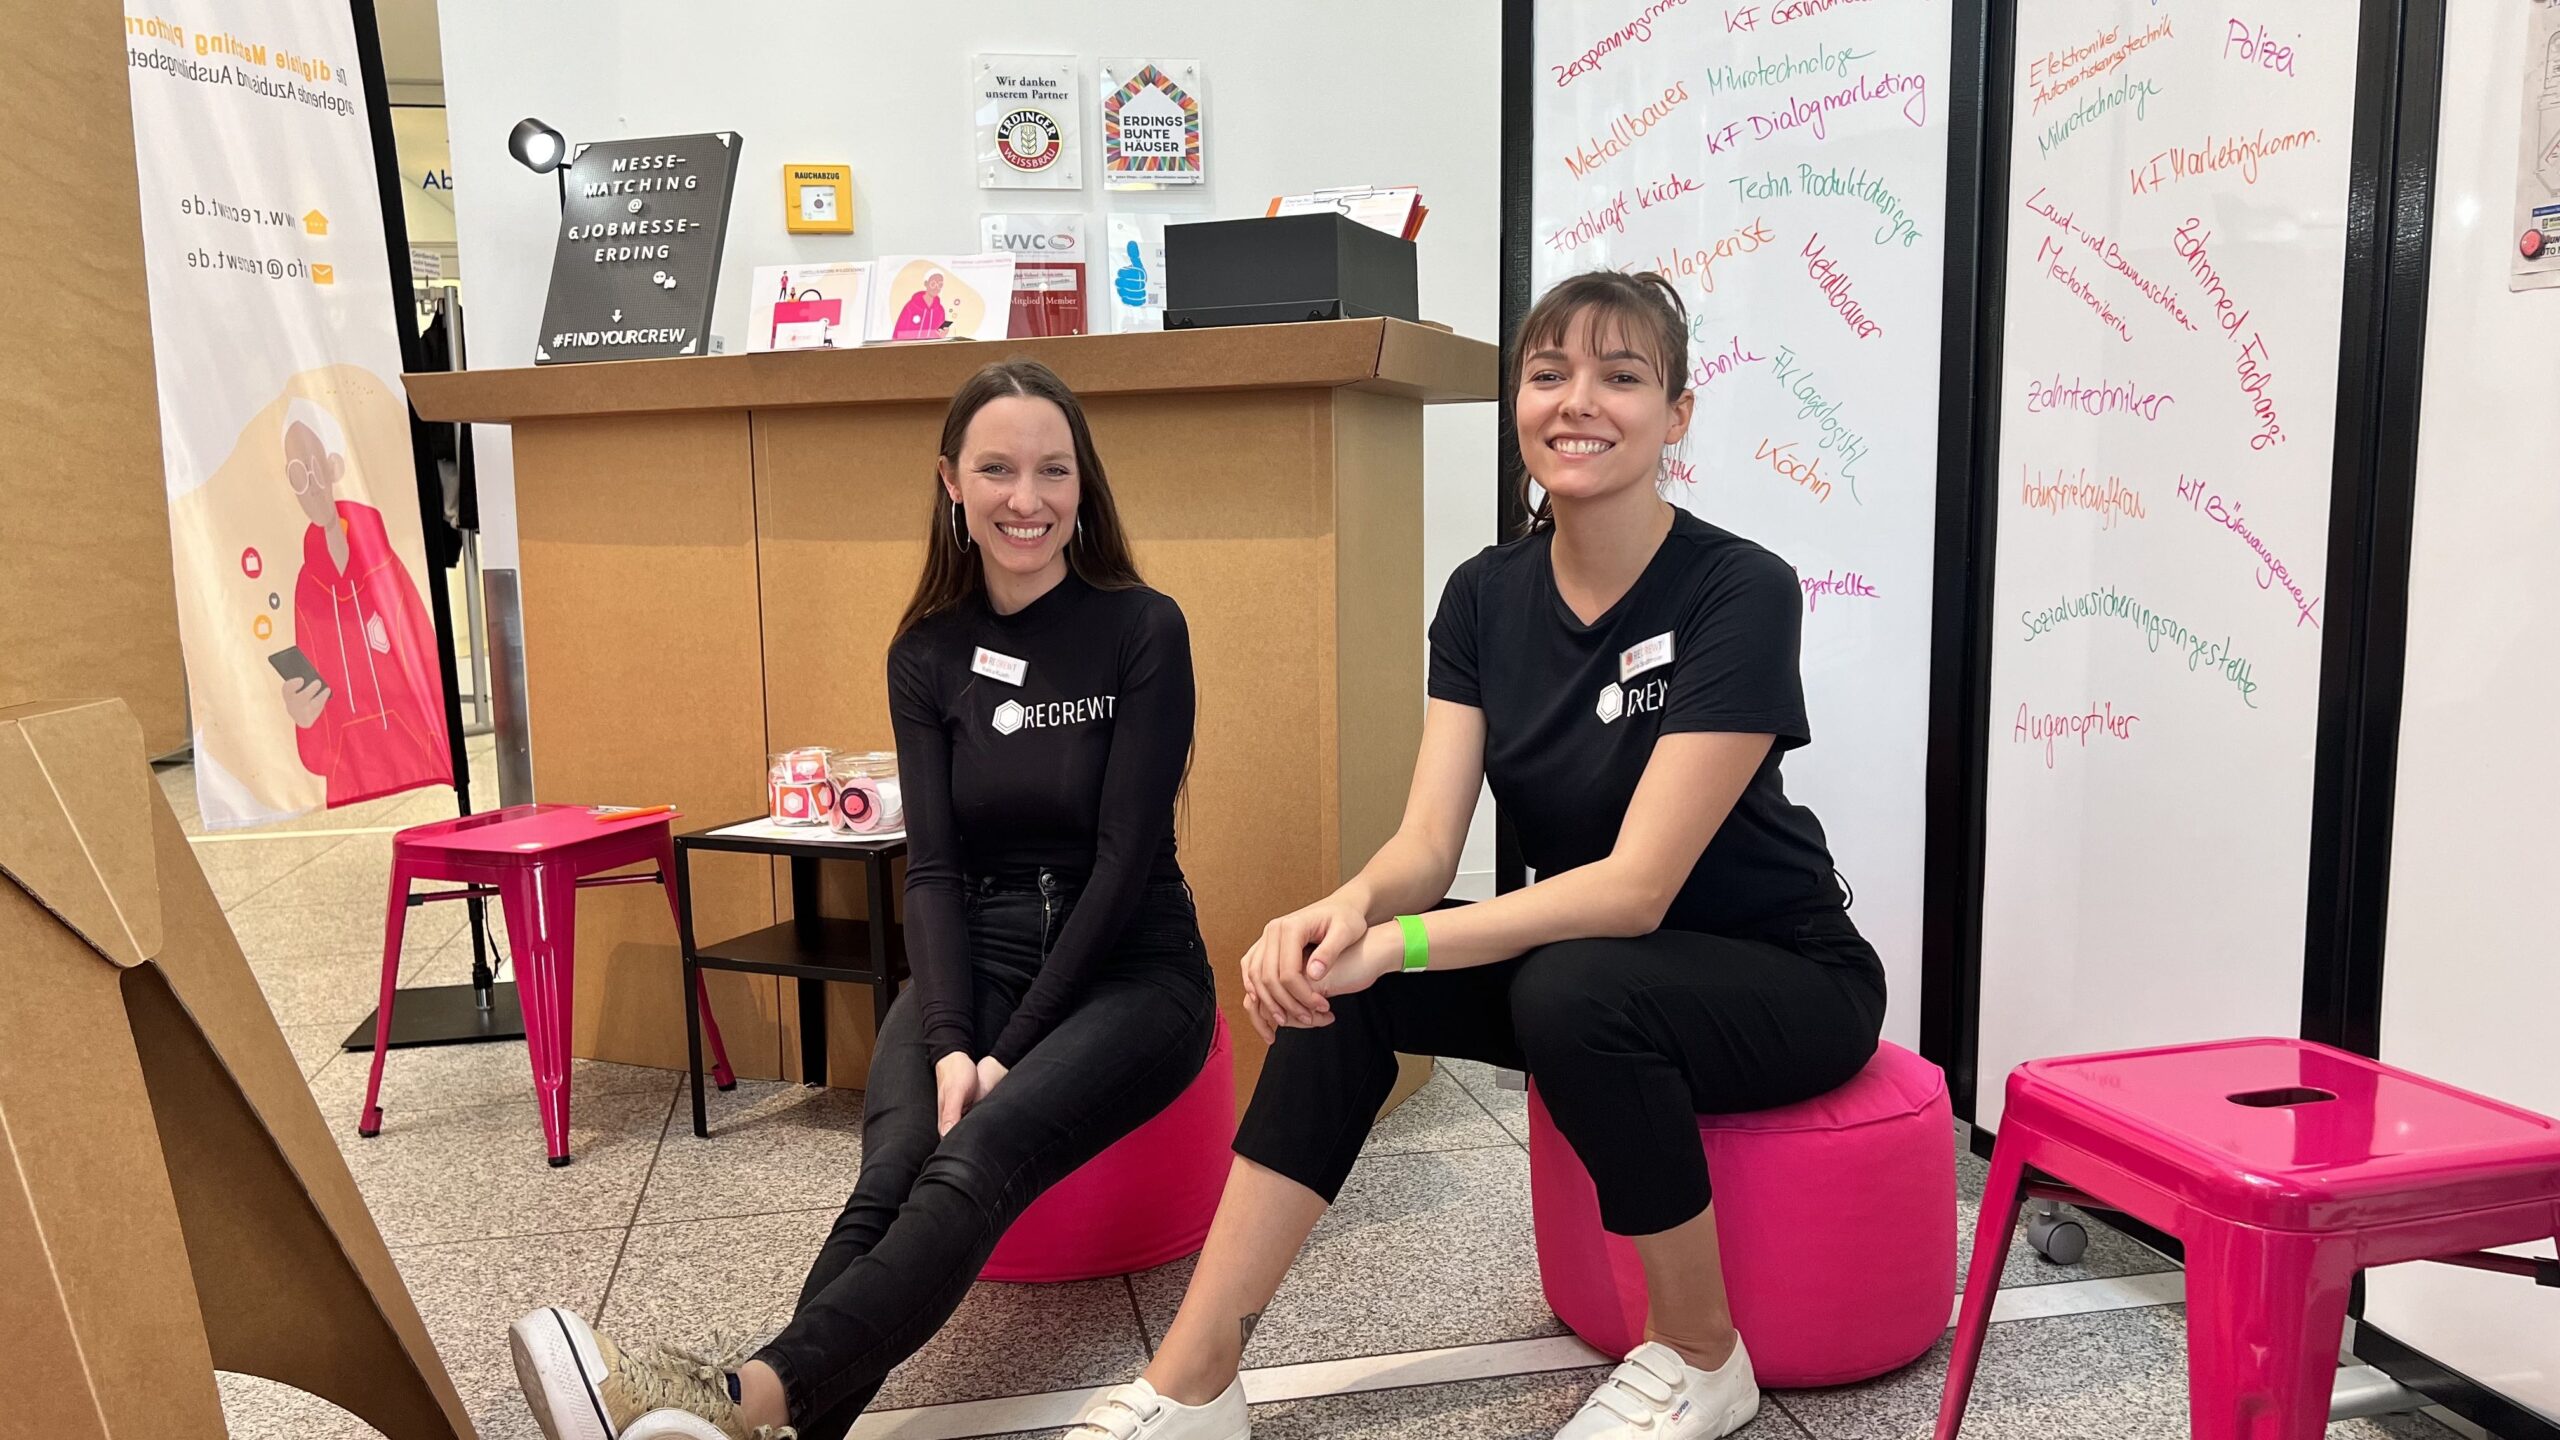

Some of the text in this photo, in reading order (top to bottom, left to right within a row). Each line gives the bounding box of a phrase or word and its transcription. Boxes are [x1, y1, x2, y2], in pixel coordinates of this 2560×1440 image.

[1724, 6, 1761, 34] KF
[2223, 18, 2302, 78] Polizei
[995, 76, 1057, 87] Wir danken
[985, 89, 1069, 100] unserem Partner
[999, 112, 1057, 137] ERDINGER
[1123, 115, 1183, 127] ERDINGS
[1706, 74, 1927, 156] KF Dialogmarketing
[1124, 128, 1170, 140] BUNTE
[1124, 141, 1180, 153] HÄUSER
[611, 154, 687, 173] MESSE-
[2130, 151, 2167, 195] KF
[794, 171, 840, 180] RAUCHABZUG
[583, 175, 698, 199] MATCHING
[1729, 170, 1793, 204] Techn.
[628, 198, 643, 214] @
[1544, 189, 1631, 255] Fachkraft
[991, 234, 1046, 250] EVVC
[594, 244, 670, 263] ERDING
[1046, 296, 1076, 305] Member
[552, 327, 686, 349] #FINDYOURCREW
[1754, 438, 1833, 504] Köchin
[1024, 695, 1116, 729] RECREWT
[2014, 701, 2141, 769] Augenoptiker
